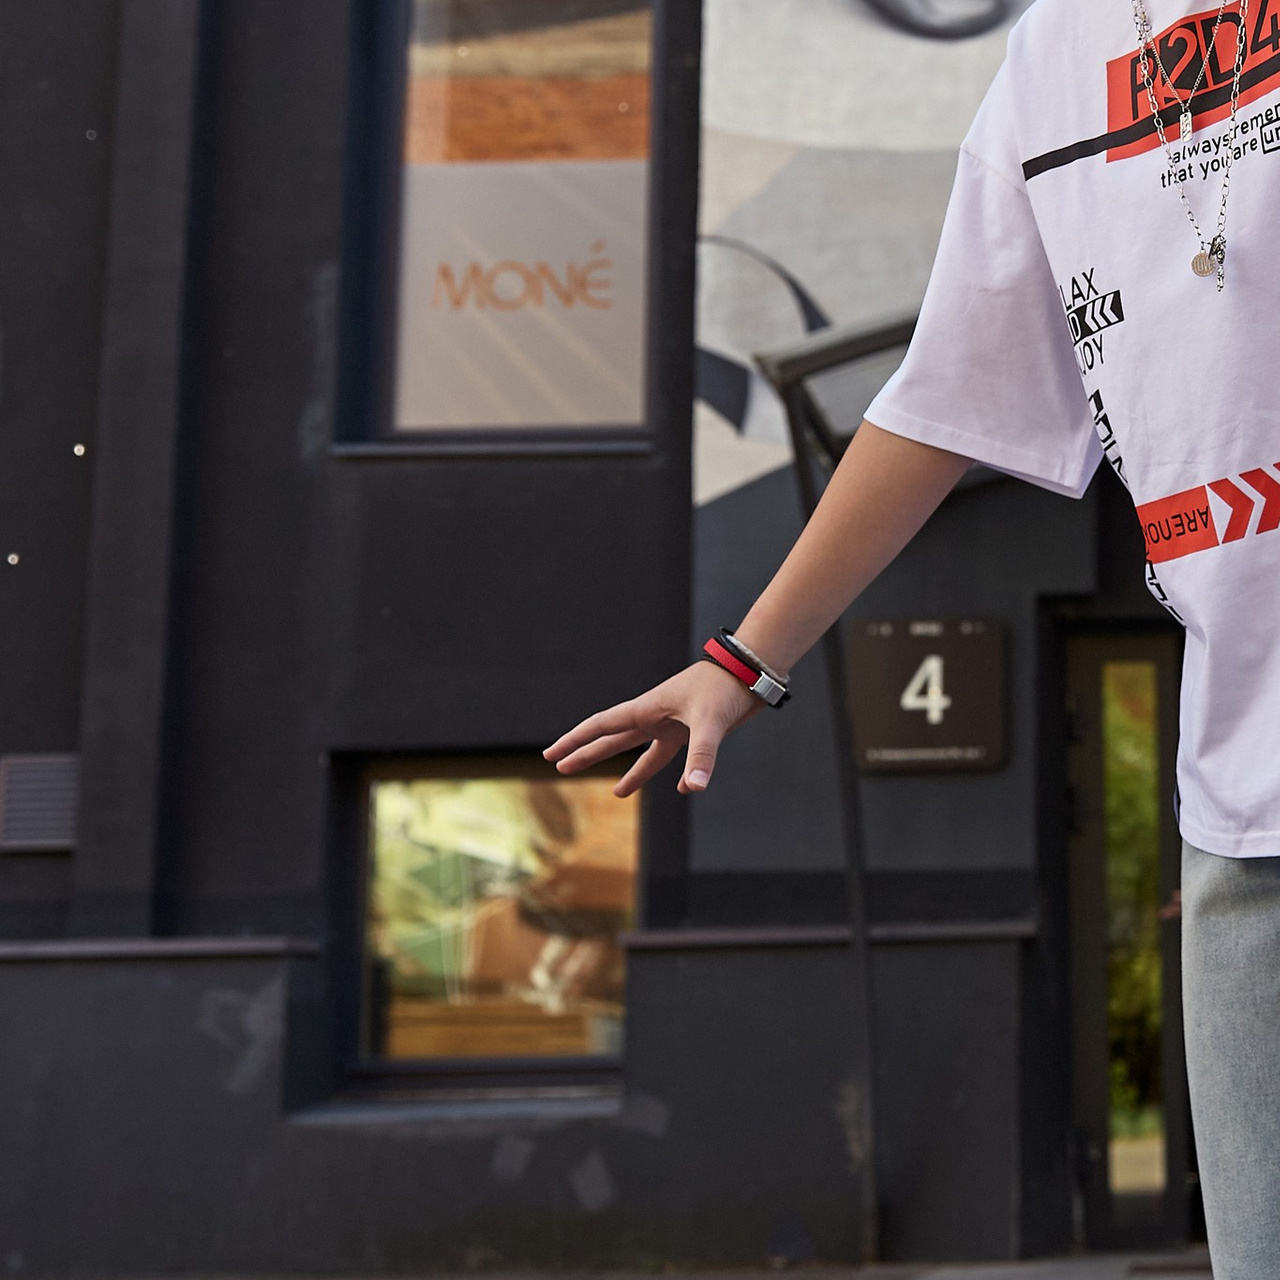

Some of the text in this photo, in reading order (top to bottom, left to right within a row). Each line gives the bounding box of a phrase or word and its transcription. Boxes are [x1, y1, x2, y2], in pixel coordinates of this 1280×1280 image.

[1161, 165, 1194, 188] that
[1200, 157, 1229, 181] you
[1233, 139, 1258, 161] are
[1173, 133, 1230, 164] always
[430, 239, 615, 312] MONÉ
[1058, 267, 1099, 312] LAX
[900, 654, 952, 726] 4
